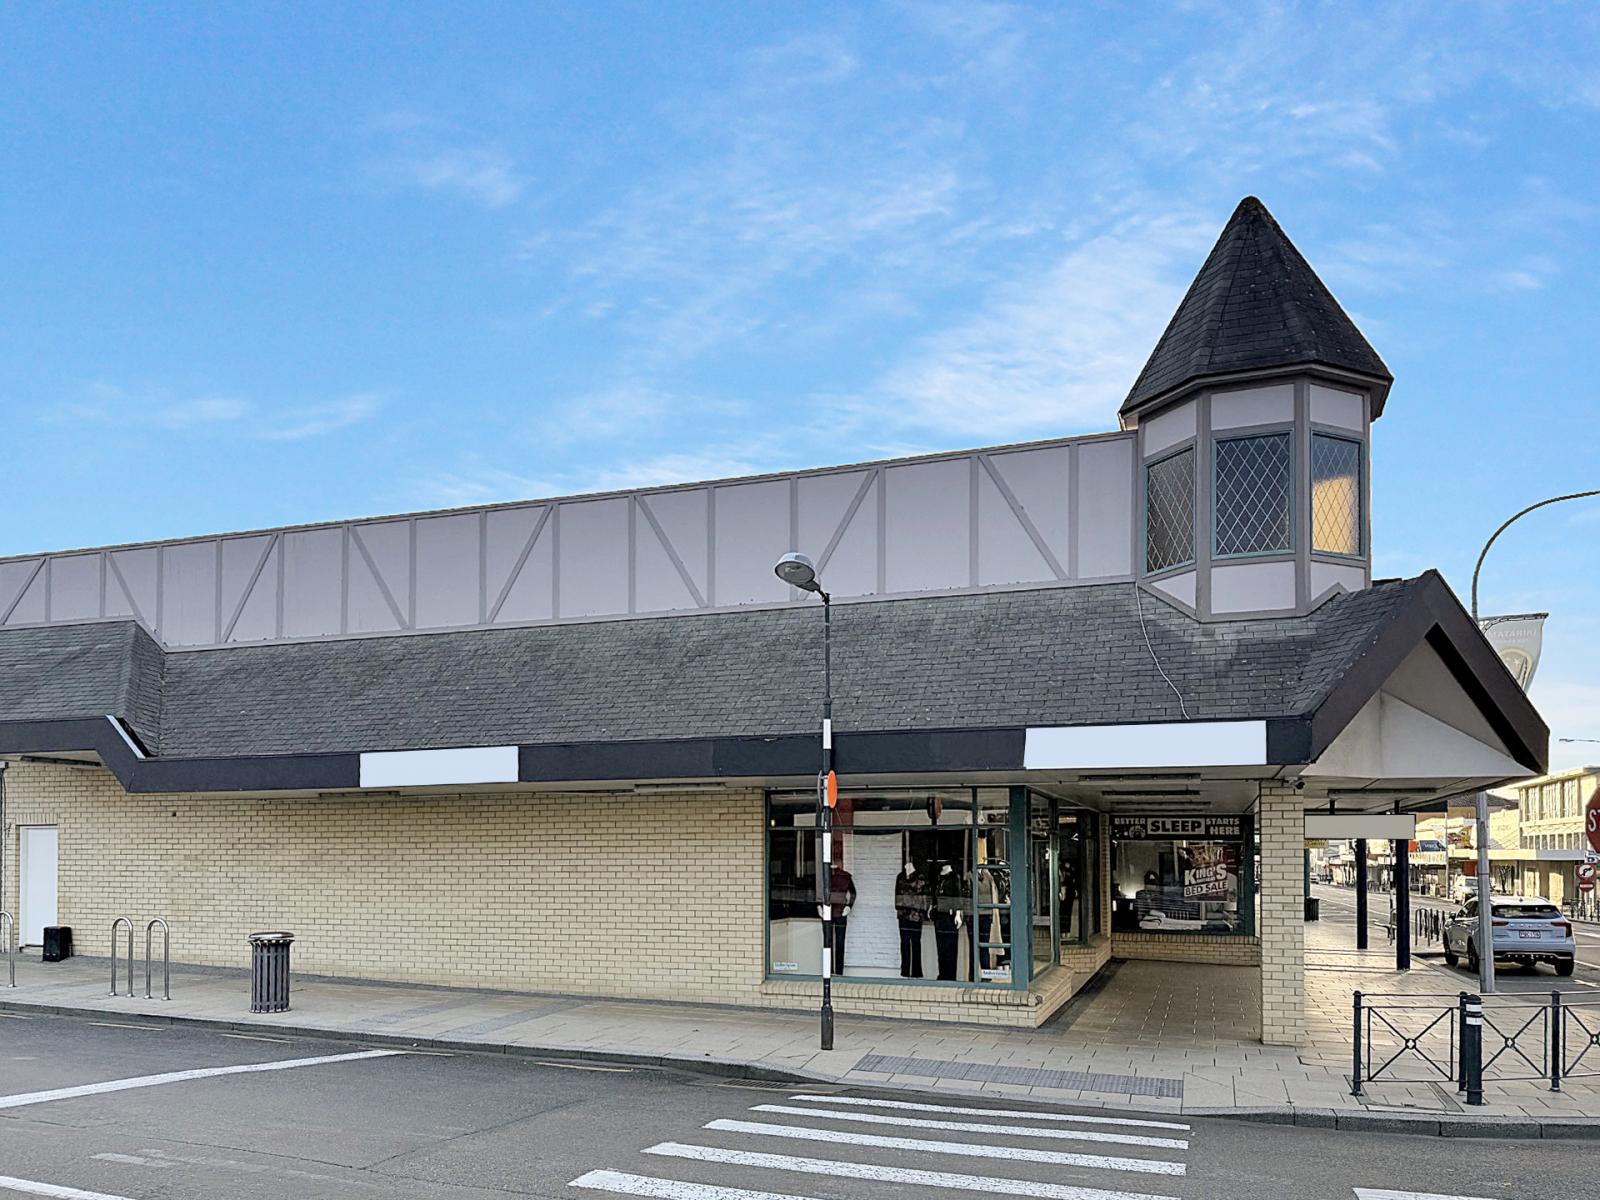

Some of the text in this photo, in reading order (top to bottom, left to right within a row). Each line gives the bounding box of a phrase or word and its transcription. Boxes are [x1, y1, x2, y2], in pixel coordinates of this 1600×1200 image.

[1114, 817, 1146, 825] BETTER
[1205, 817, 1240, 825] STARTS
[1150, 820, 1202, 833] SLEEP
[1209, 826, 1240, 835] HERE
[1185, 885, 1203, 896] BED
[1205, 881, 1228, 892] SALE
